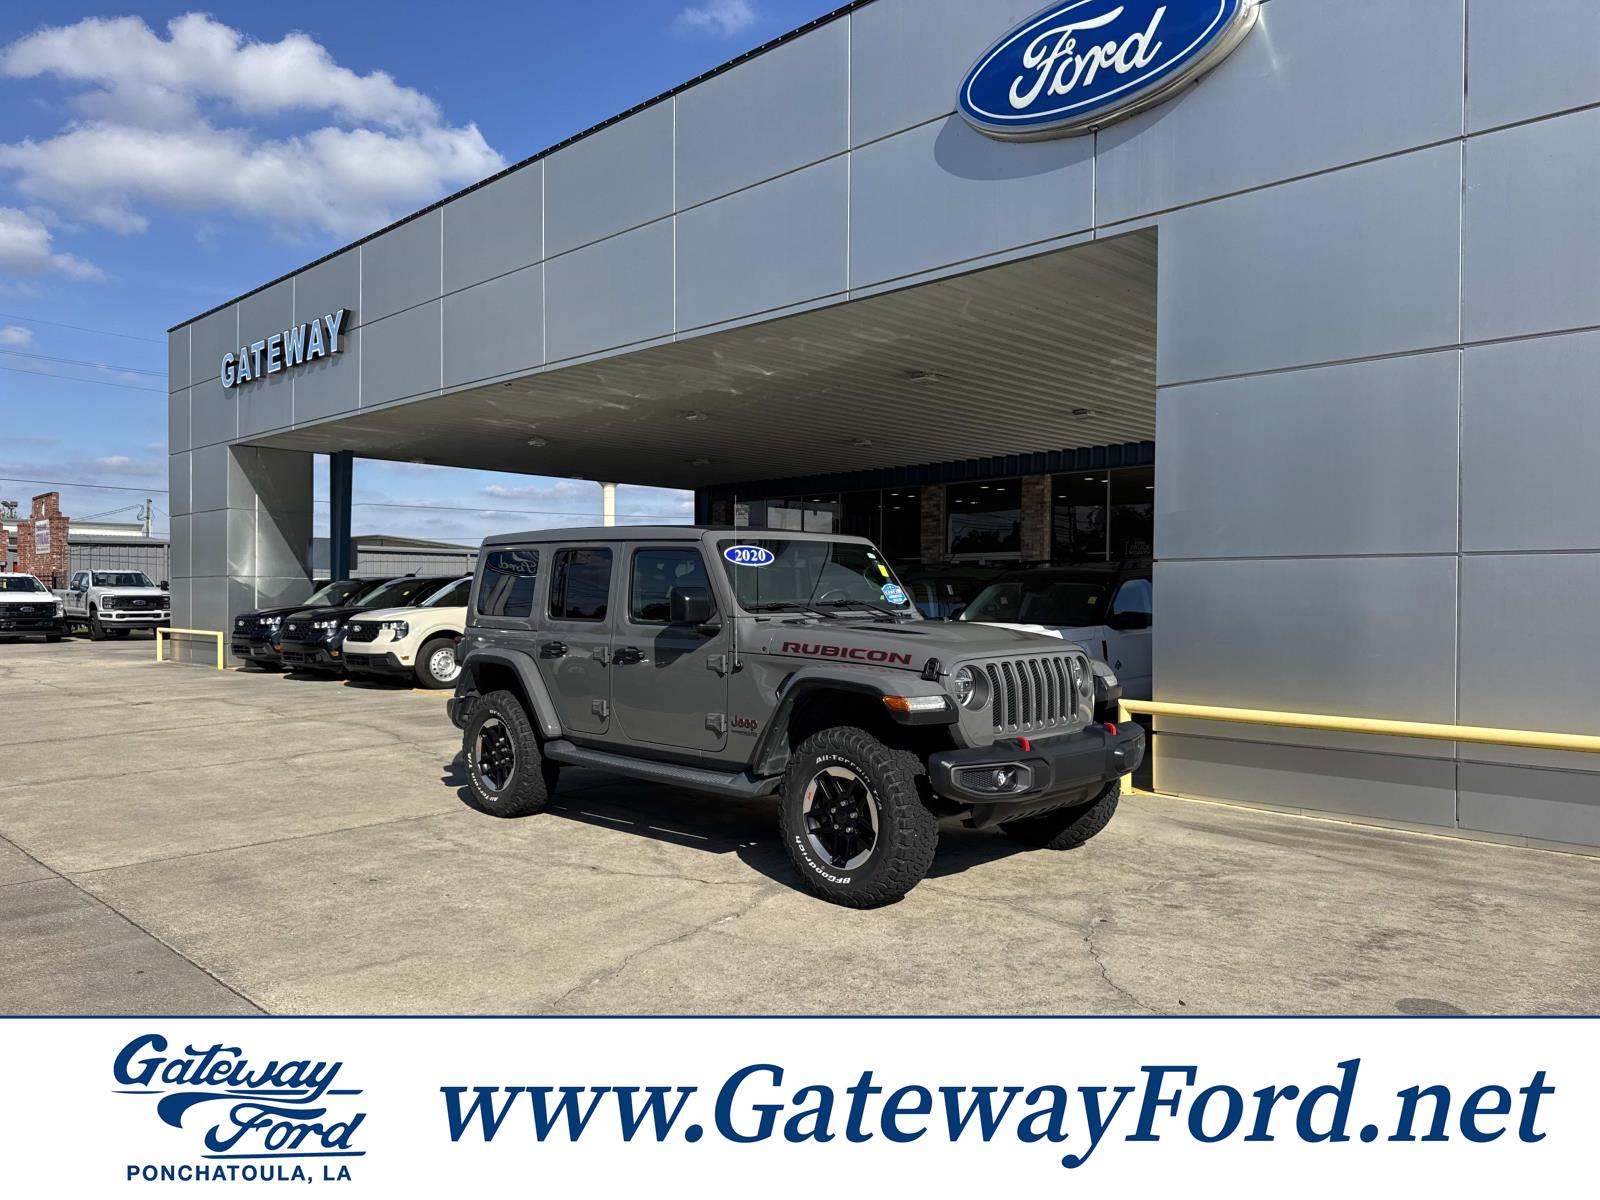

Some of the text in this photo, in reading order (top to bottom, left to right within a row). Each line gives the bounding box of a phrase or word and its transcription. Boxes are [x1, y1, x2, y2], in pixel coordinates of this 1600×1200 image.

[1008, 5, 1167, 110] Ford
[221, 309, 345, 388] GATEWAY
[734, 549, 766, 562] 2020
[782, 641, 913, 665] RUBICON
[731, 714, 758, 731] Jeep
[795, 835, 851, 884] BFGoodrich
